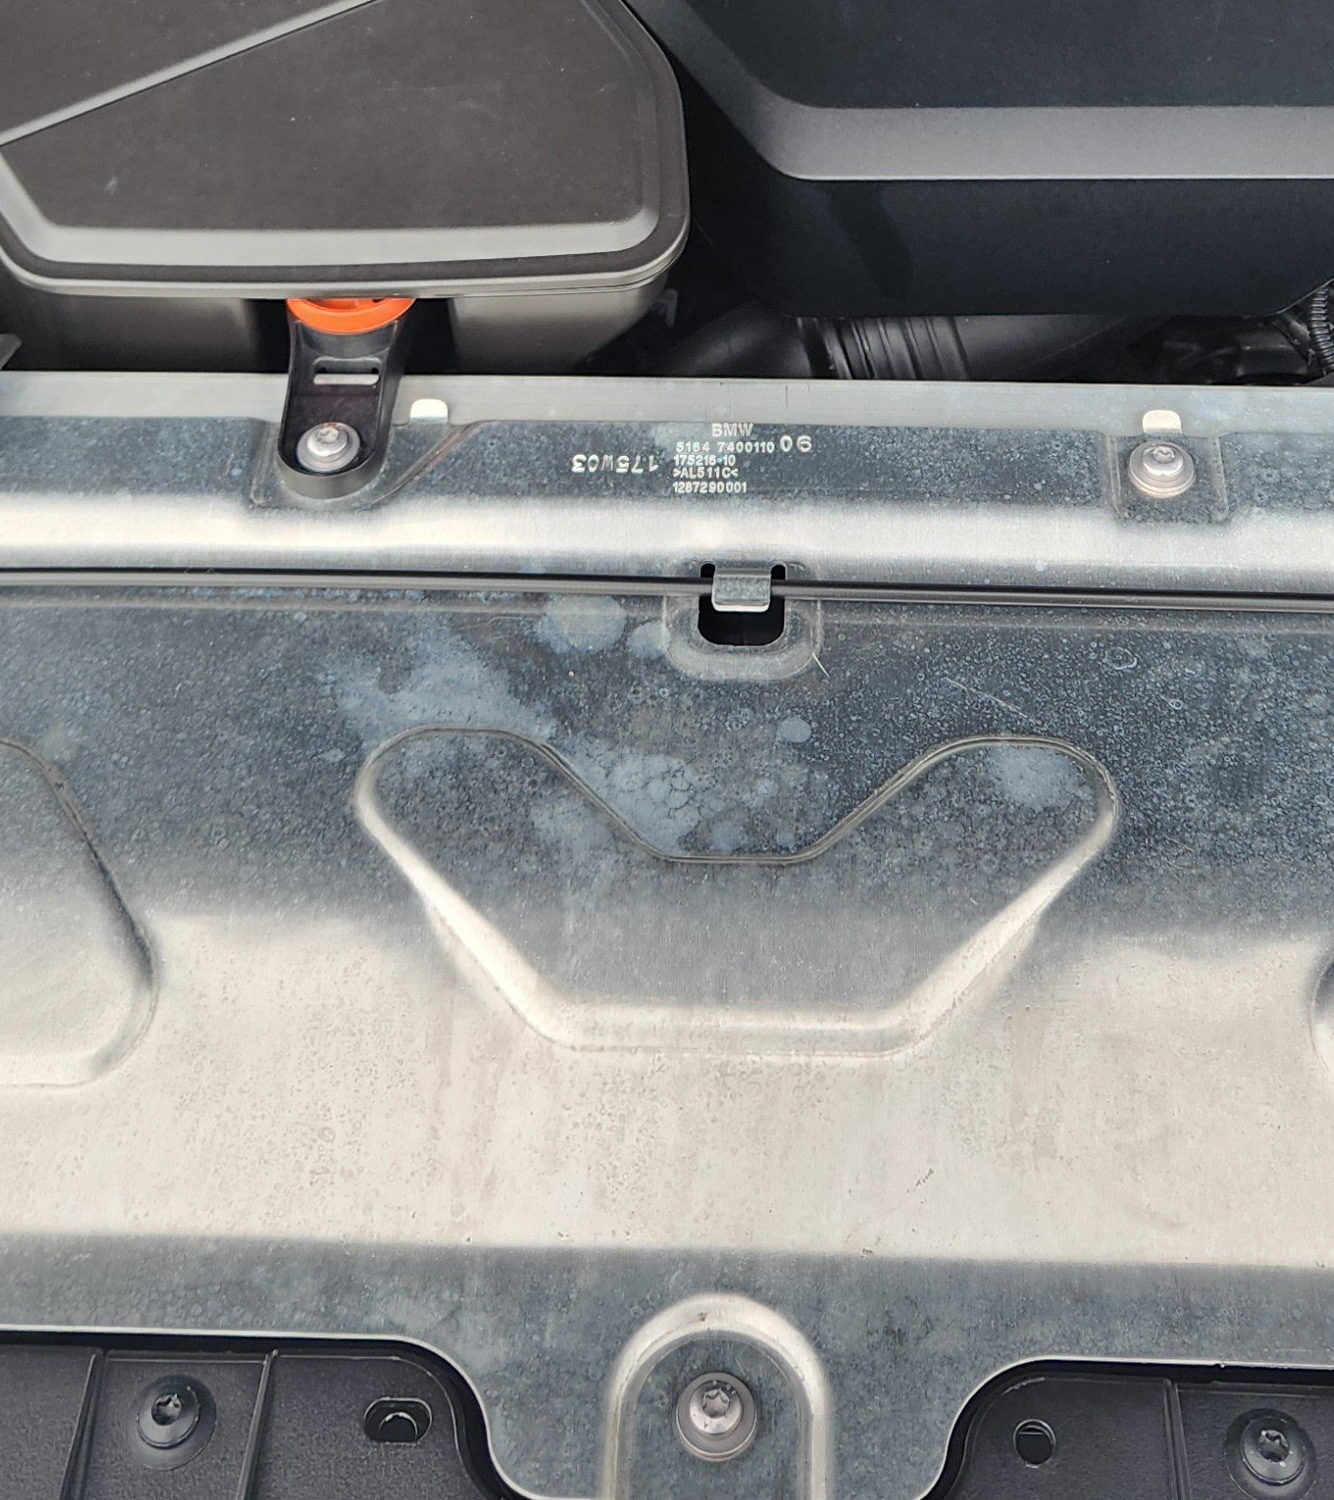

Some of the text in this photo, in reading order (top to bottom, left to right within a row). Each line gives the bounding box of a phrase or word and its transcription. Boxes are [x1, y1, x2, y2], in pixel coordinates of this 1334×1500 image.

[711, 423, 754, 438] BMW
[675, 441, 775, 453] 5164 7400110
[780, 435, 812, 453] 06
[672, 481, 748, 494] 1287290001
